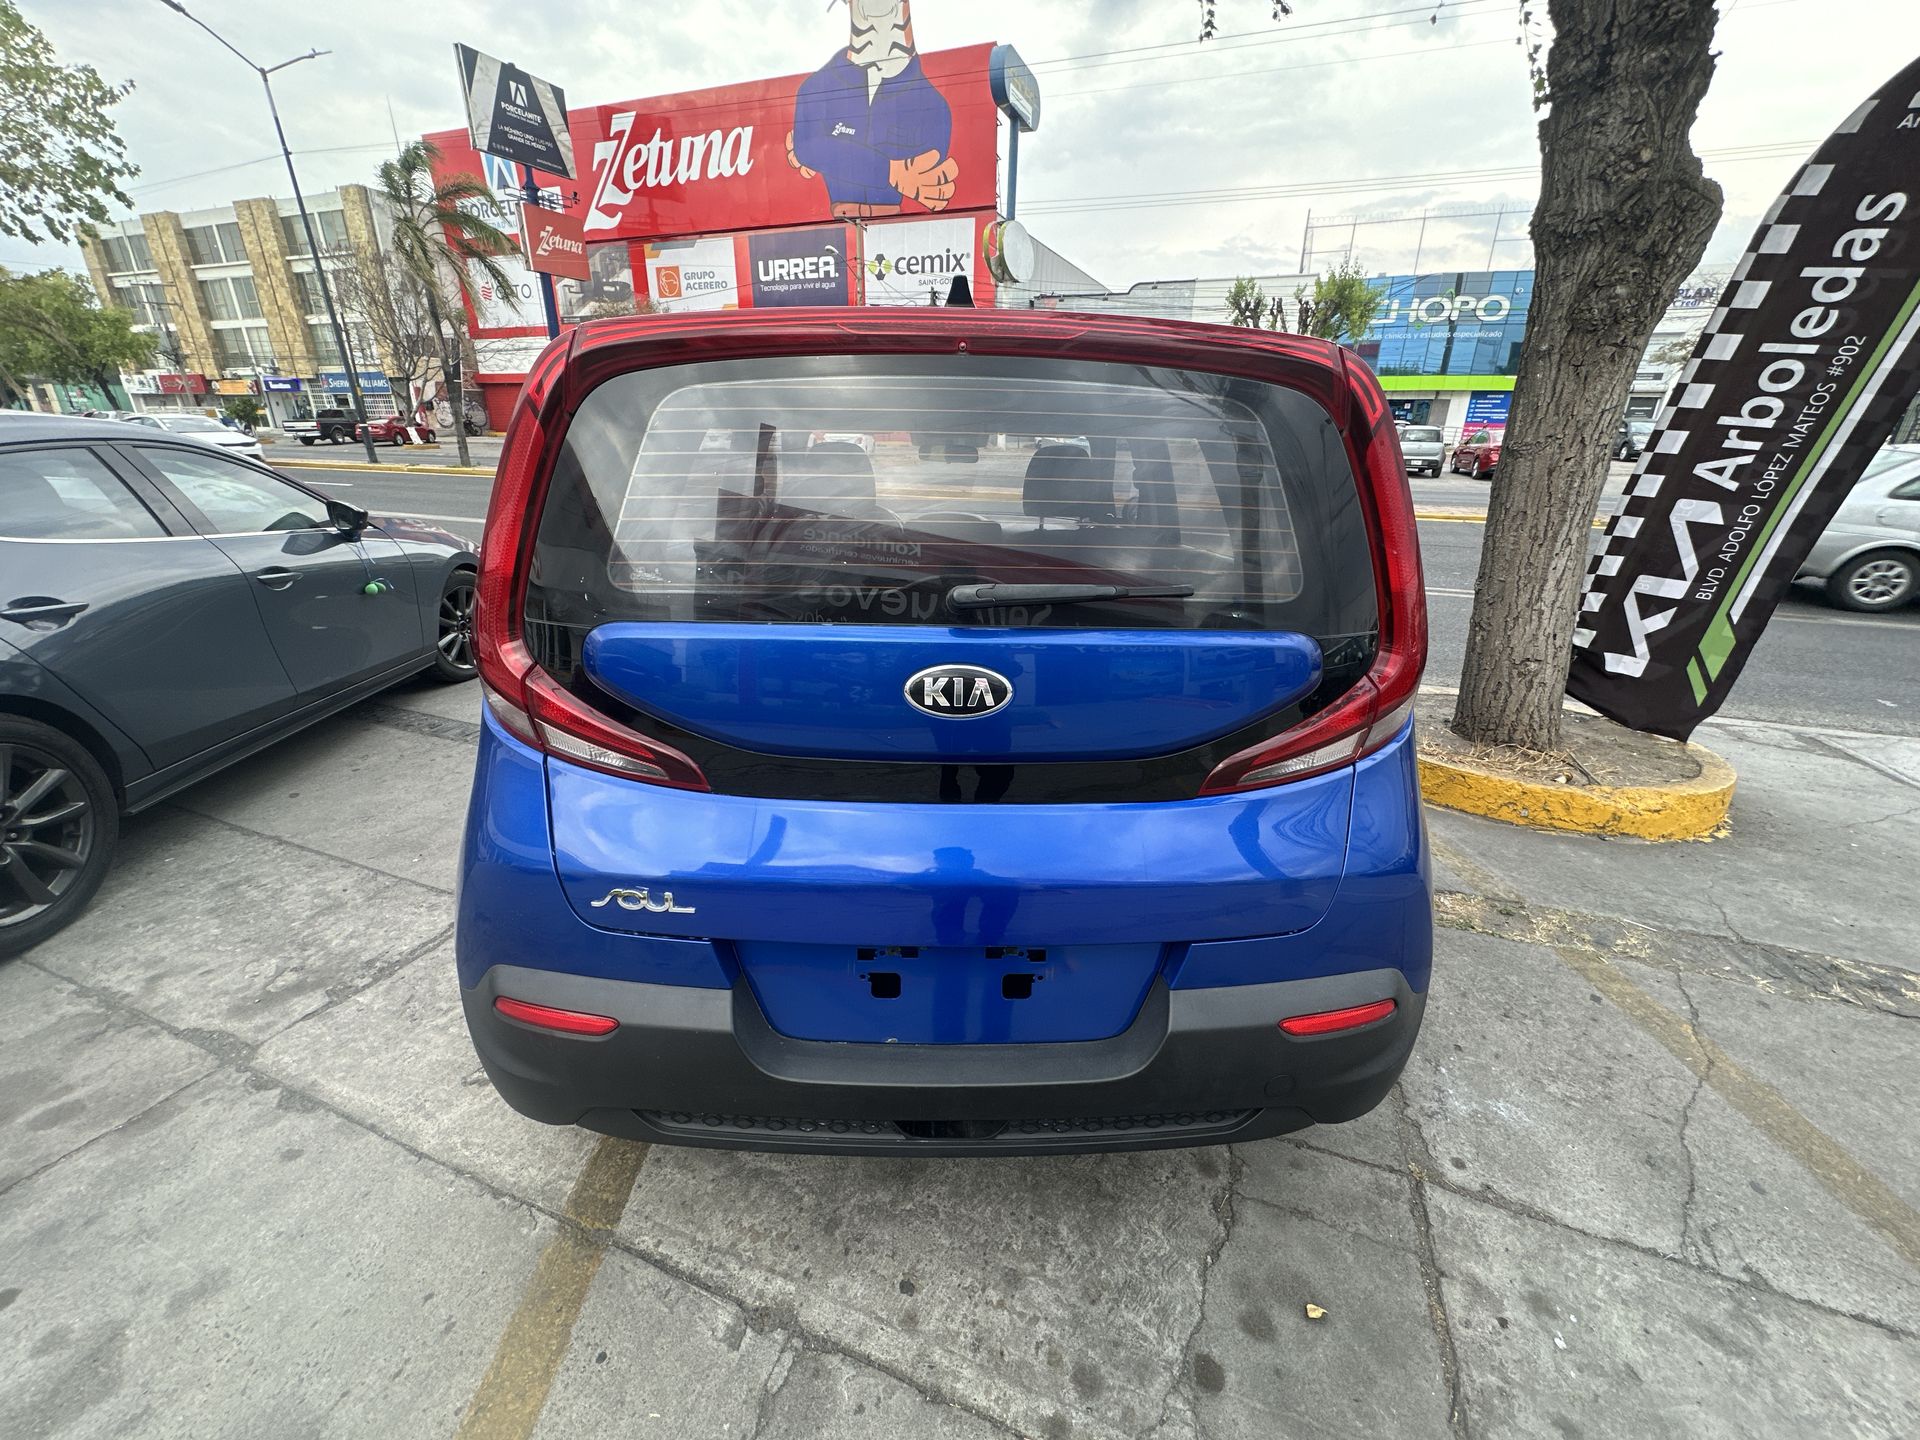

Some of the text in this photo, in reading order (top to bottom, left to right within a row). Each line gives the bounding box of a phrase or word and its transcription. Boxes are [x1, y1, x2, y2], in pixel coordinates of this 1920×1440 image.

[501, 101, 542, 123] PORCELANITE
[583, 111, 754, 232] Zetuna
[536, 225, 583, 256] Zetuna
[684, 271, 715, 281] GRUPO
[894, 248, 966, 275] cemix
[685, 280, 728, 291] ACERERO
[789, 283, 802, 291] para
[821, 281, 836, 290] agua
[1692, 192, 1908, 492] Arboledas
[1695, 335, 1867, 601] BLVD. ADOLFO LÓPEZ MATEOS #902
[922, 676, 996, 707] KIA
[590, 886, 696, 915] SOUL
